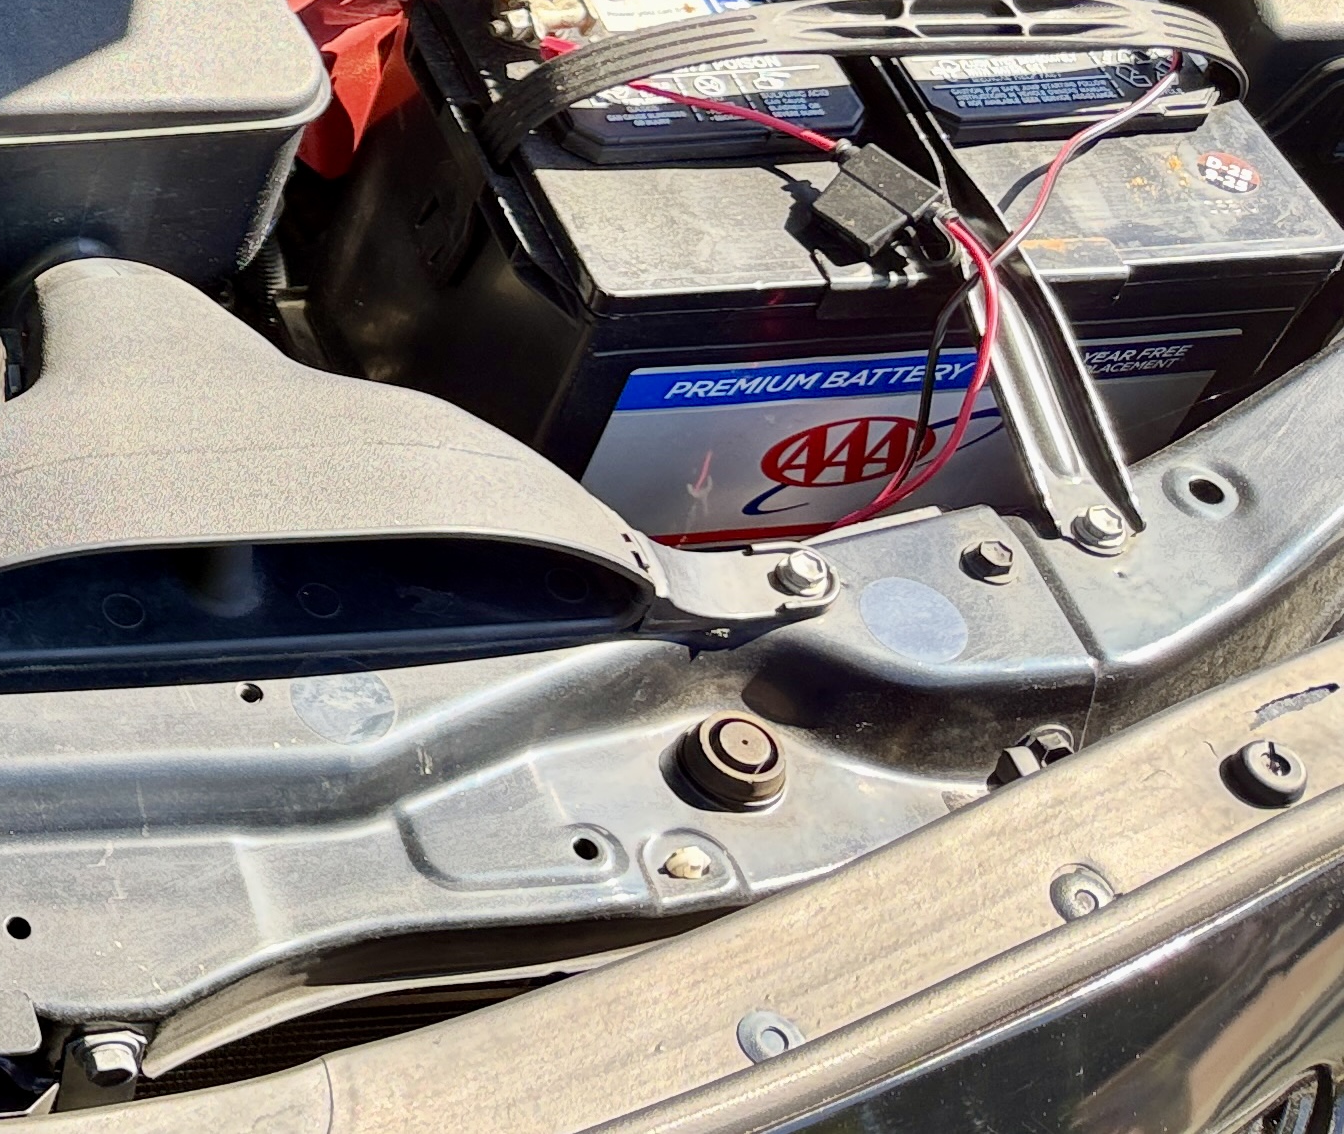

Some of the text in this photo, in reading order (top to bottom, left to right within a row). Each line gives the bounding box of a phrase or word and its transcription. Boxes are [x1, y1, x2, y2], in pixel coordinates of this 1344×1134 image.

[1205, 155, 1253, 181] D-25
[1082, 344, 1194, 364] YEAR FREE
[663, 361, 977, 400] PREMIUM BATTERY
[770, 418, 928, 486] AAA
